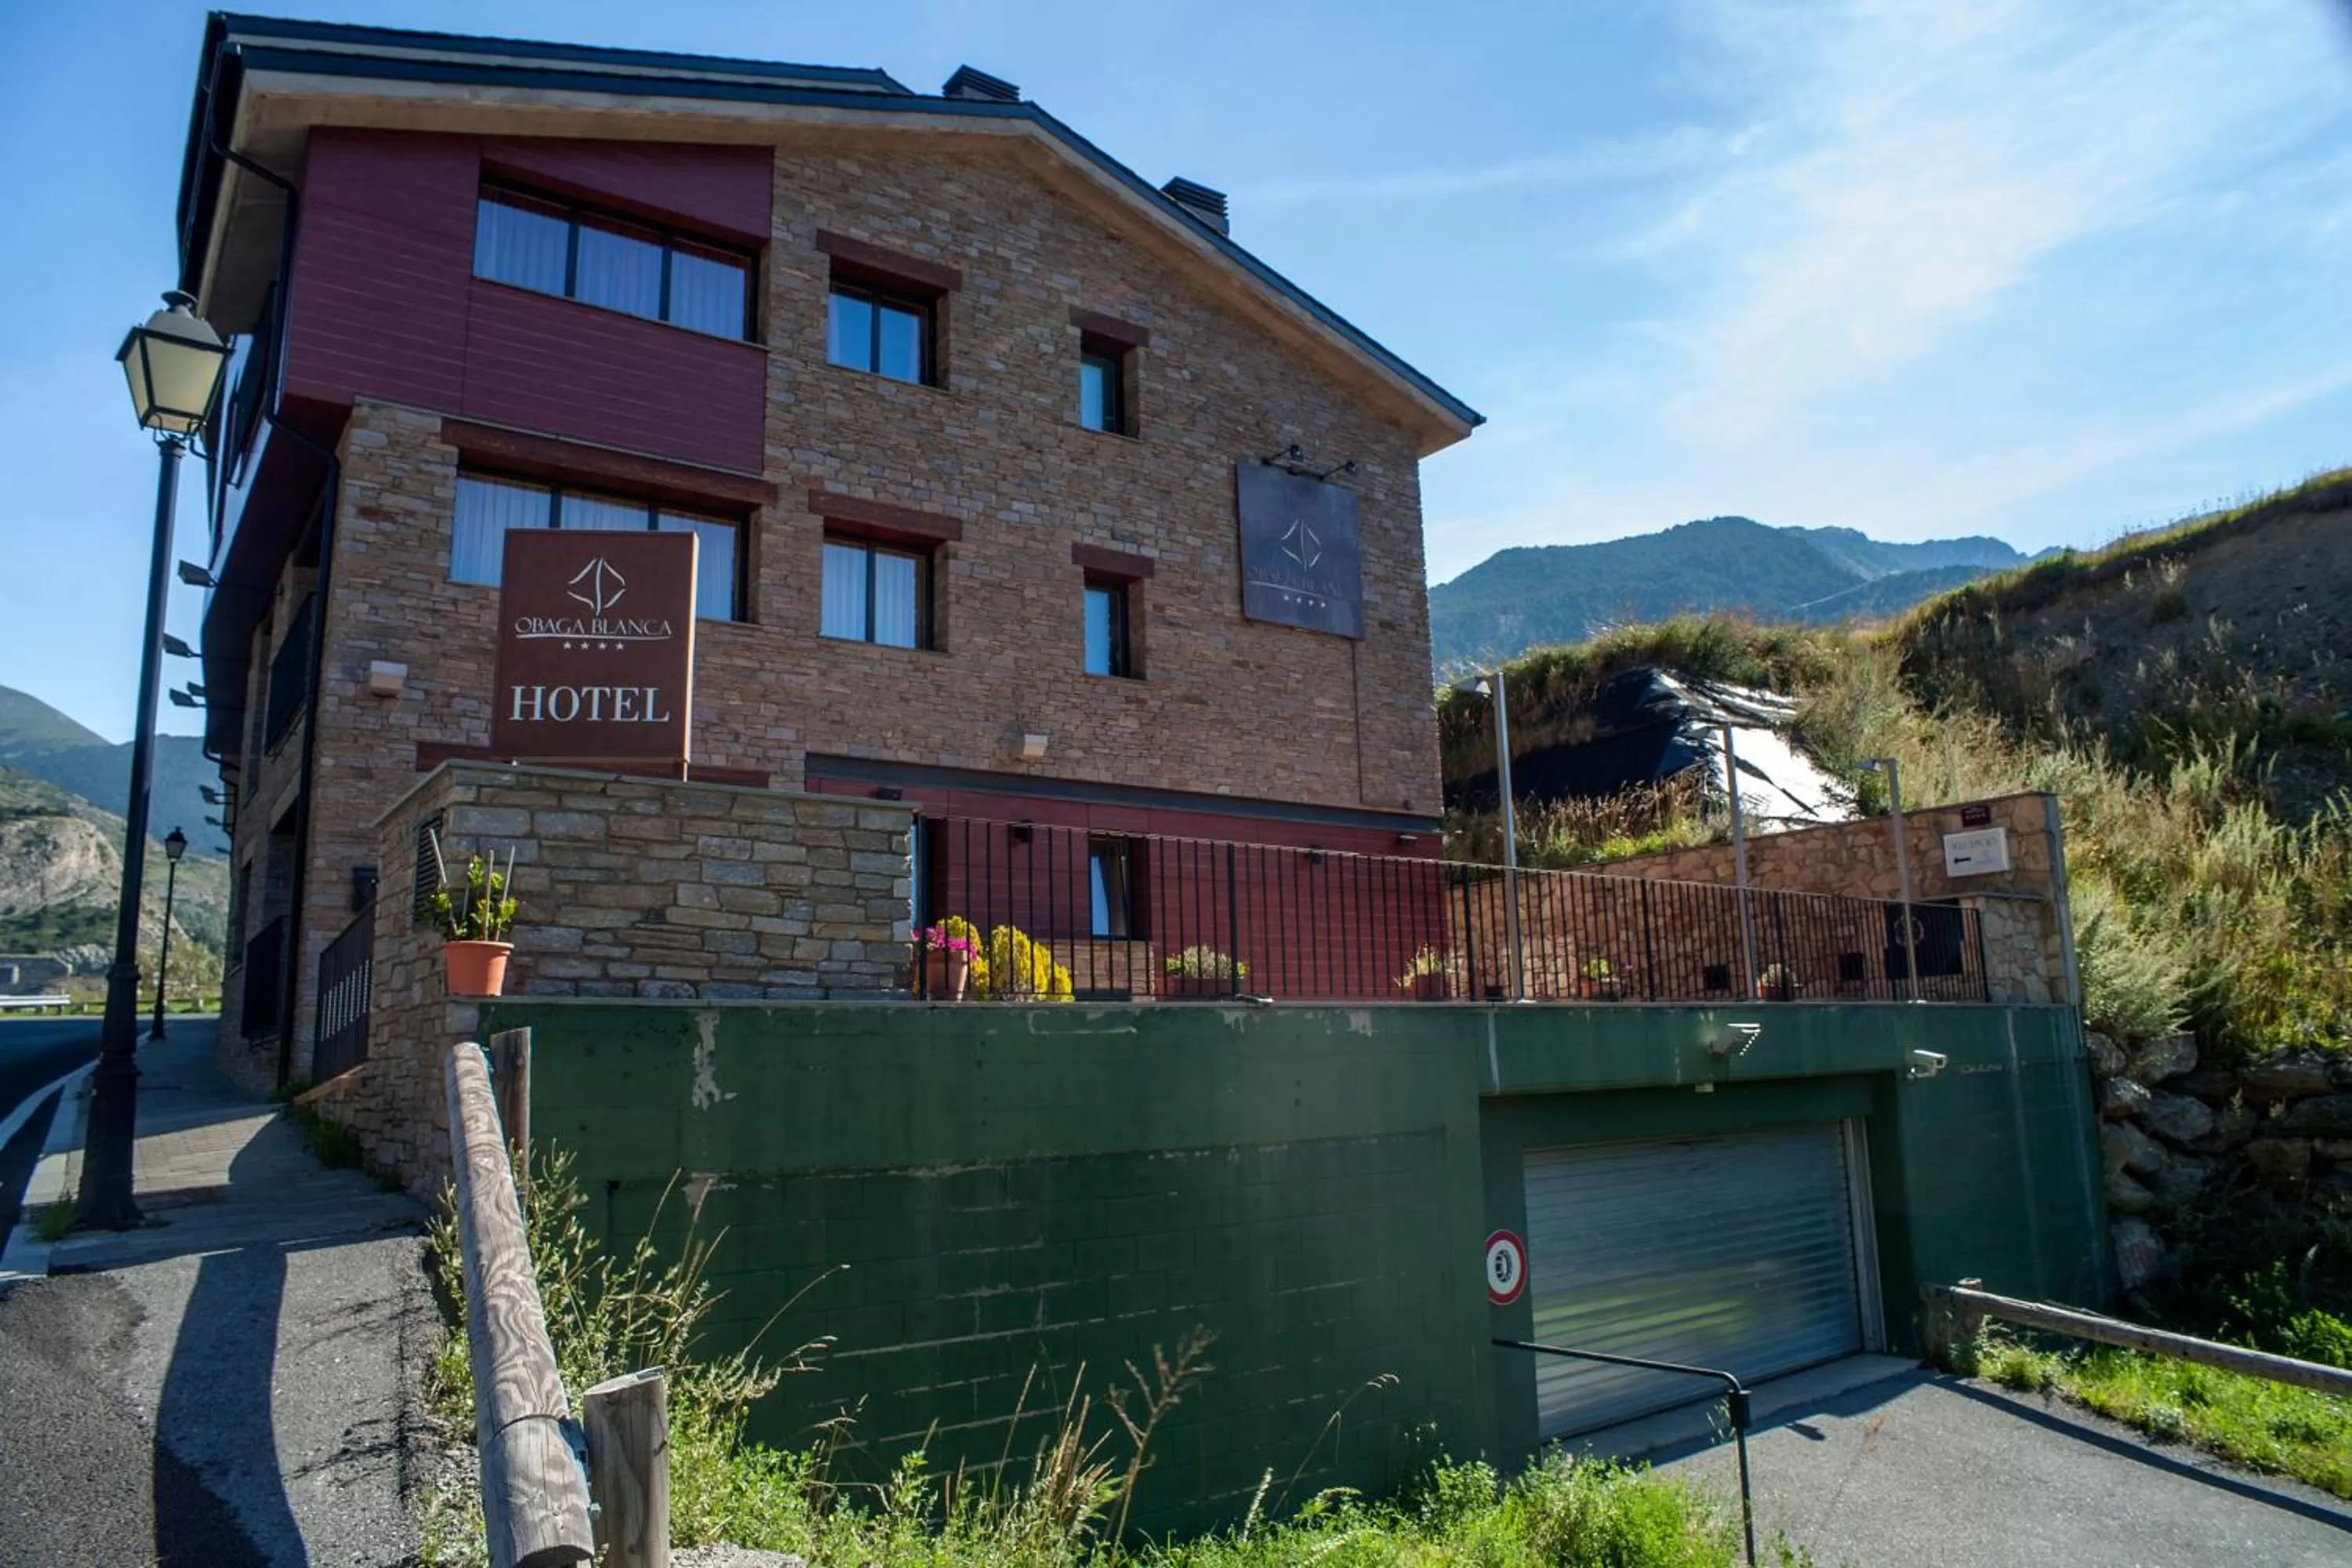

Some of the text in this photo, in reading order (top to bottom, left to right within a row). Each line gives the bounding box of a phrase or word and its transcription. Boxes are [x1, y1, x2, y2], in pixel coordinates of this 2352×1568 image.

[514, 616, 673, 636] OBAGA BLANCA
[508, 685, 671, 722] HOTEL
